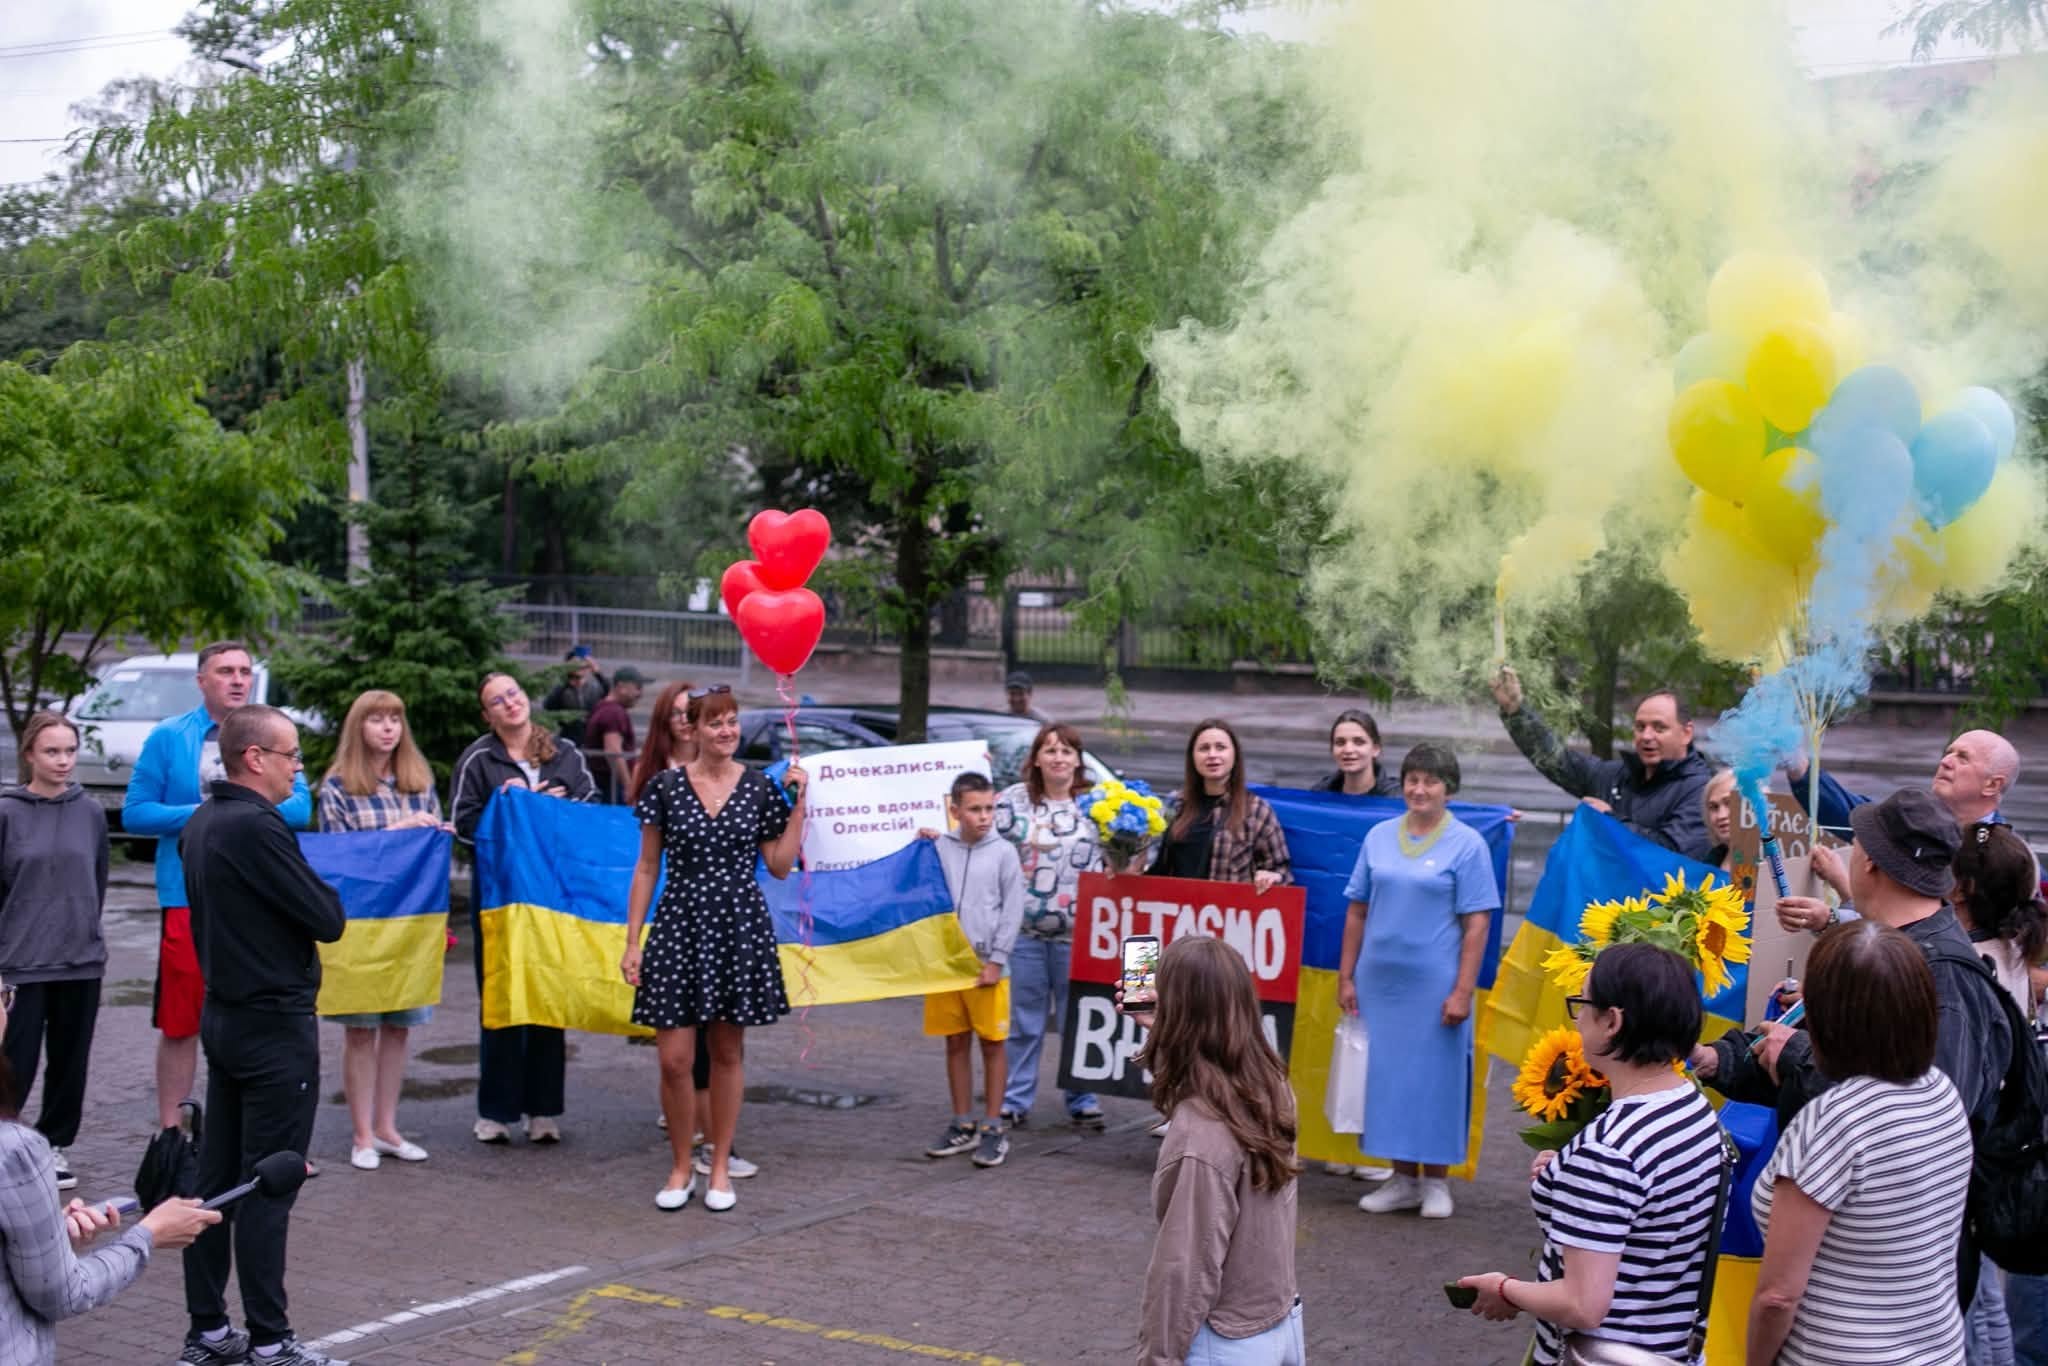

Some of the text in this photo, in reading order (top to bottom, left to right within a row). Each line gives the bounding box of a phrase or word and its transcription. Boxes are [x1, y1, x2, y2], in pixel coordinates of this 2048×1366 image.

[803, 799, 942, 819] ітаємо вдома,
[832, 817, 915, 835] Олексій!
